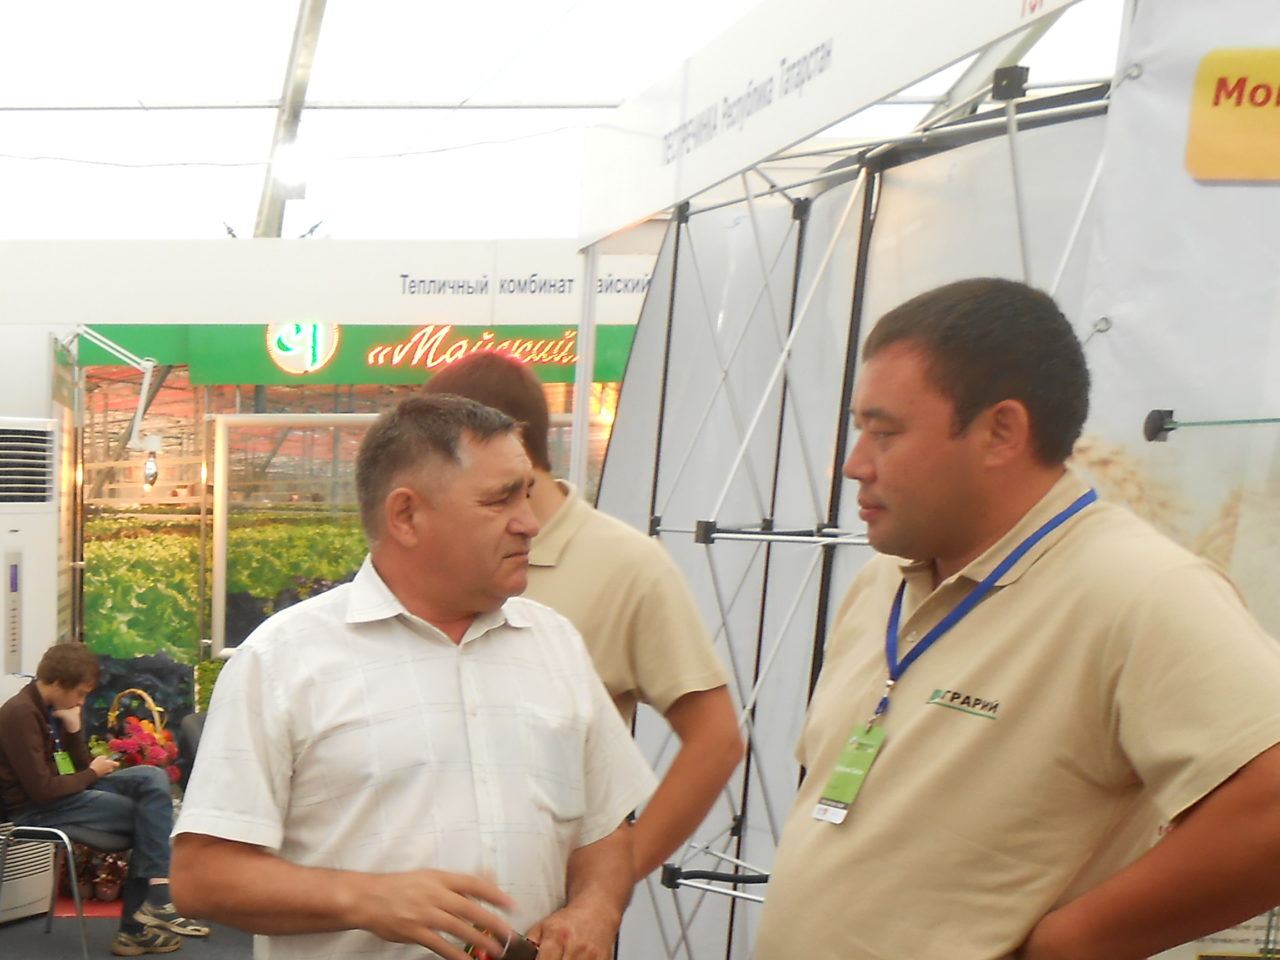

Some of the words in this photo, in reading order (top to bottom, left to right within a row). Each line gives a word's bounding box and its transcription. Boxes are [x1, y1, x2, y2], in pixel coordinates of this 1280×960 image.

[1212, 77, 1280, 107] Мо
[400, 274, 488, 295] Тепличный
[499, 273, 574, 295] комбинат
[596, 274, 651, 295] айский
[941, 690, 999, 713] ГРАРИЙ
